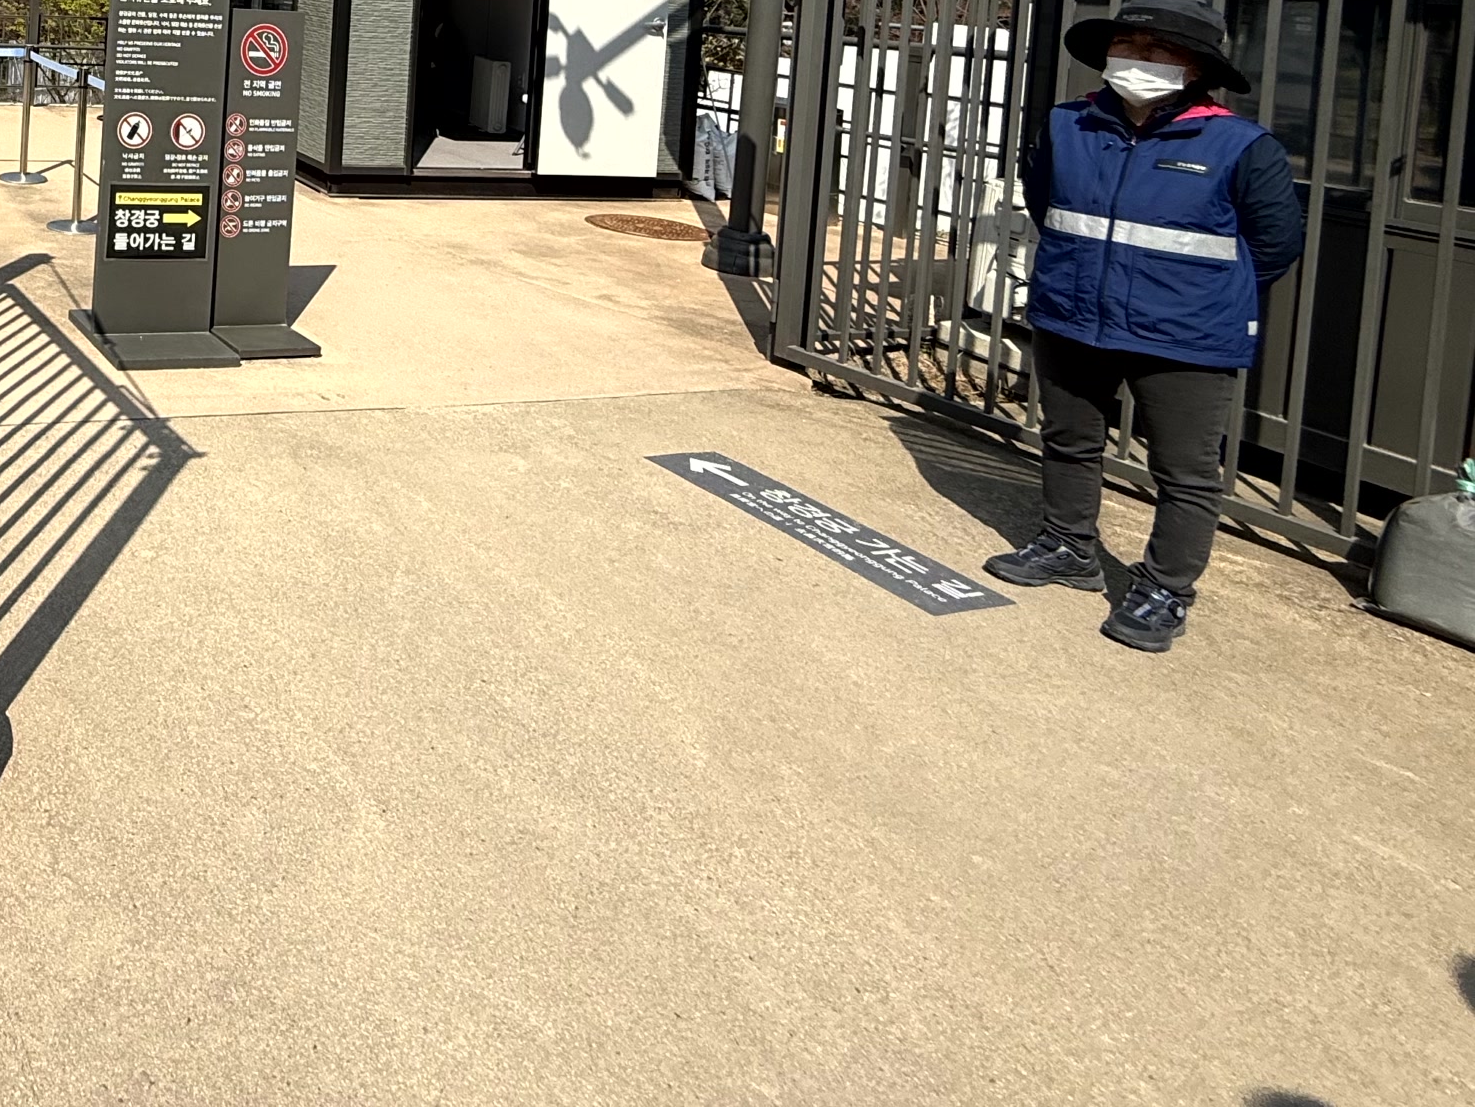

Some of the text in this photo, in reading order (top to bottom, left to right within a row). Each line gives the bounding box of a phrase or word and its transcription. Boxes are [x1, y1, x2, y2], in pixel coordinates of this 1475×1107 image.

[244, 80, 282, 90] 전 지역 금연
[114, 209, 160, 228] 창경궁
[114, 233, 196, 251] 들어가는 길
[760, 489, 984, 599] 창경궁 가는 길
[773, 508, 794, 518] way
[905, 580, 947, 602] Palace
